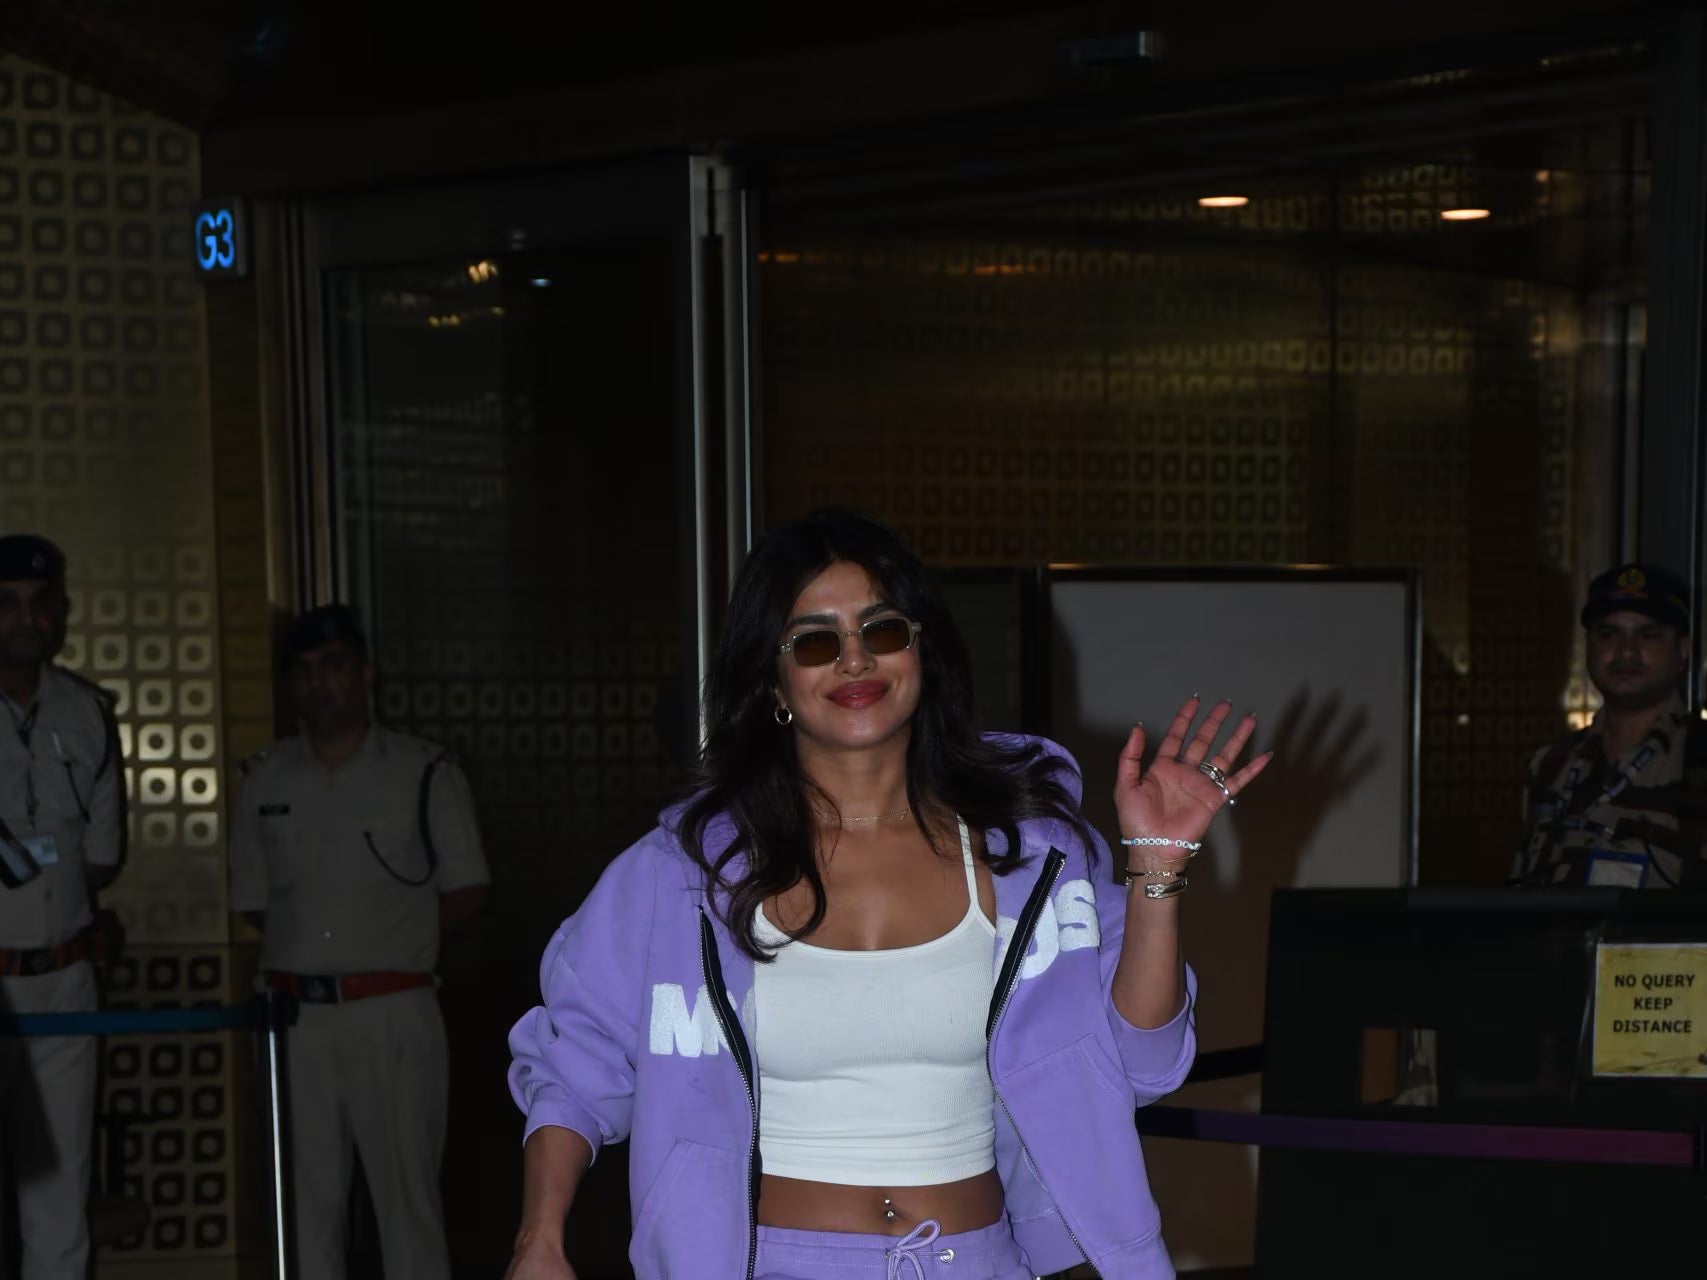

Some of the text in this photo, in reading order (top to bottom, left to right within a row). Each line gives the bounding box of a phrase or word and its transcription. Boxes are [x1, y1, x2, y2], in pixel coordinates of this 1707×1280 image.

[194, 208, 236, 272] G3
[1614, 974, 1696, 990] NO QUERY
[1633, 997, 1673, 1011] KEEP
[1613, 1020, 1692, 1033] DISTANCE
